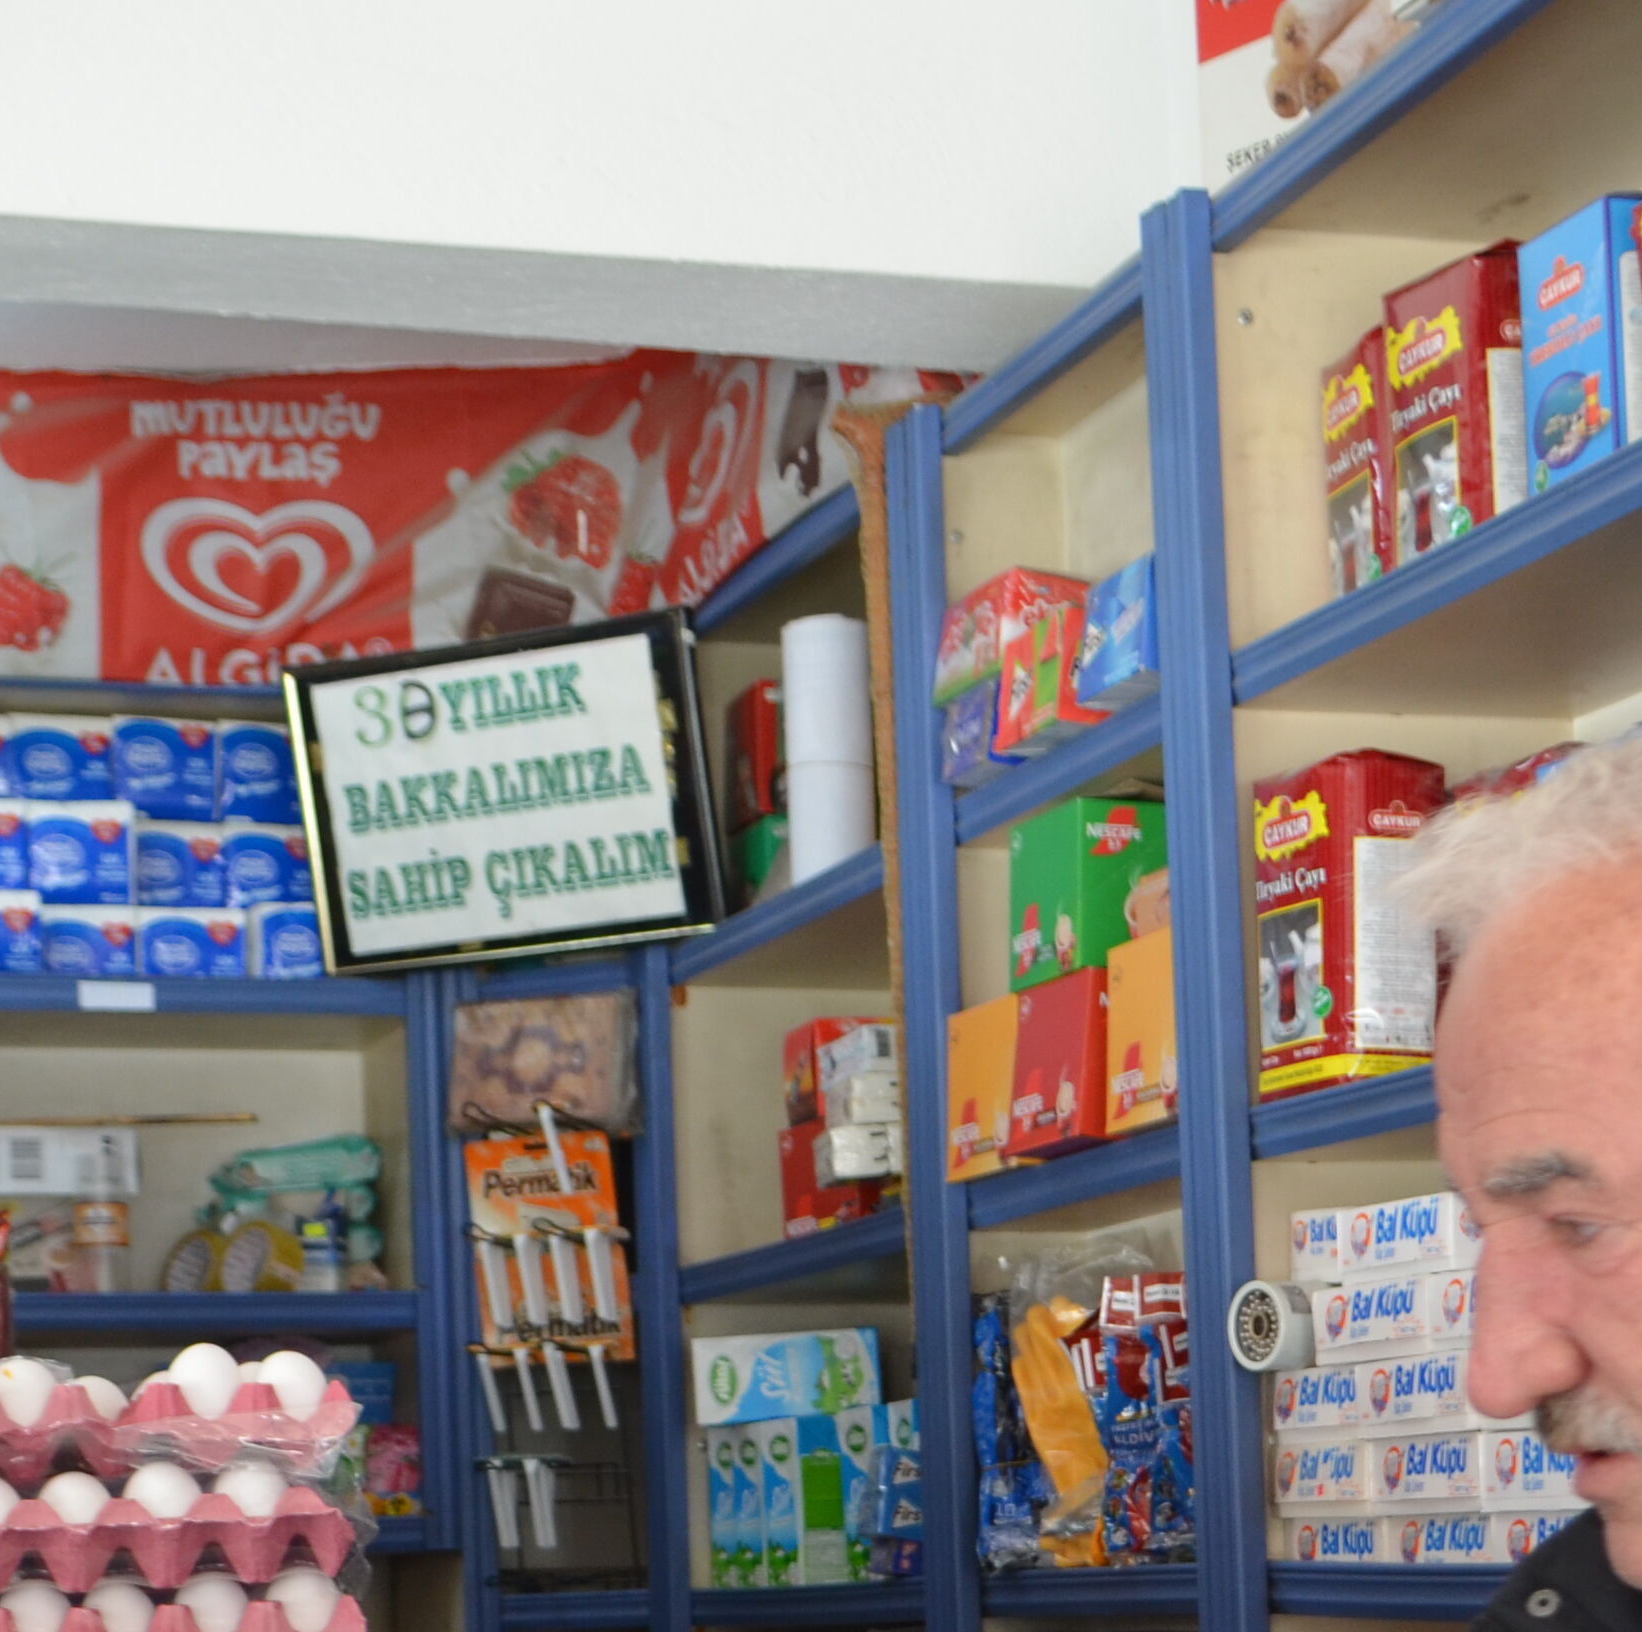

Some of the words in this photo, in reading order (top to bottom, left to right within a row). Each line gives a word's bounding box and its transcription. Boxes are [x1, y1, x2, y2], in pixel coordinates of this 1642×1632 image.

[440, 661, 587, 733] YILLIK
[343, 742, 653, 836] BAKKALIMIZA
[345, 846, 473, 926] SAHİP
[484, 825, 677, 923] ÇIKALIM
[1374, 1208, 1397, 1245] Bal
[1399, 1196, 1439, 1243] Küpü
[1350, 1290, 1373, 1323] Bal
[1374, 1279, 1416, 1323] Küpü
[1298, 1376, 1320, 1407] Bal
[1321, 1367, 1356, 1410] Küpü
[1393, 1364, 1415, 1397] Bal
[1416, 1356, 1456, 1399] Küpü
[1298, 1450, 1320, 1480] Bal
[1405, 1442, 1428, 1476] Bal
[1429, 1437, 1468, 1476] Küpü
[1521, 1436, 1545, 1474] Bal
[1320, 1525, 1342, 1555] Bal
[1342, 1523, 1374, 1556] Küpü
[1424, 1518, 1447, 1552] Bal
[1448, 1514, 1486, 1556] Küpü
